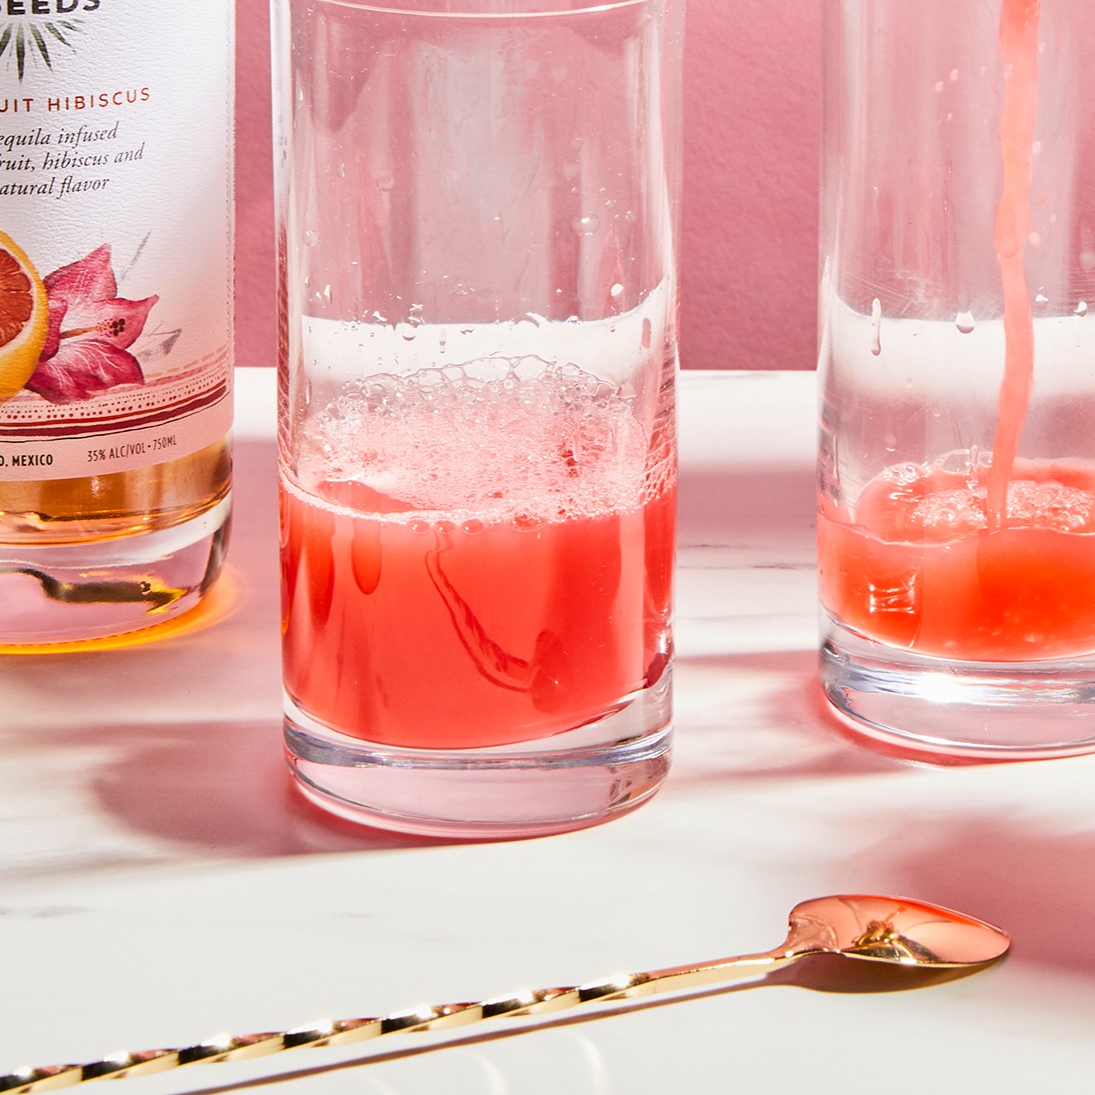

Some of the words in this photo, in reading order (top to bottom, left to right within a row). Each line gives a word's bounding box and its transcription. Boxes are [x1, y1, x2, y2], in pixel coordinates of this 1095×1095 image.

[47, 87, 151, 112] HIBISCUS
[57, 121, 119, 149] infused
[0, 152, 35, 173] ruit,
[42, 150, 108, 171] hibiscus
[114, 142, 146, 164] and
[56, 174, 110, 200] flavor
[12, 453, 53, 467] MEXICO
[87, 449, 107, 463] 35%
[153, 434, 177, 452] 750ML
